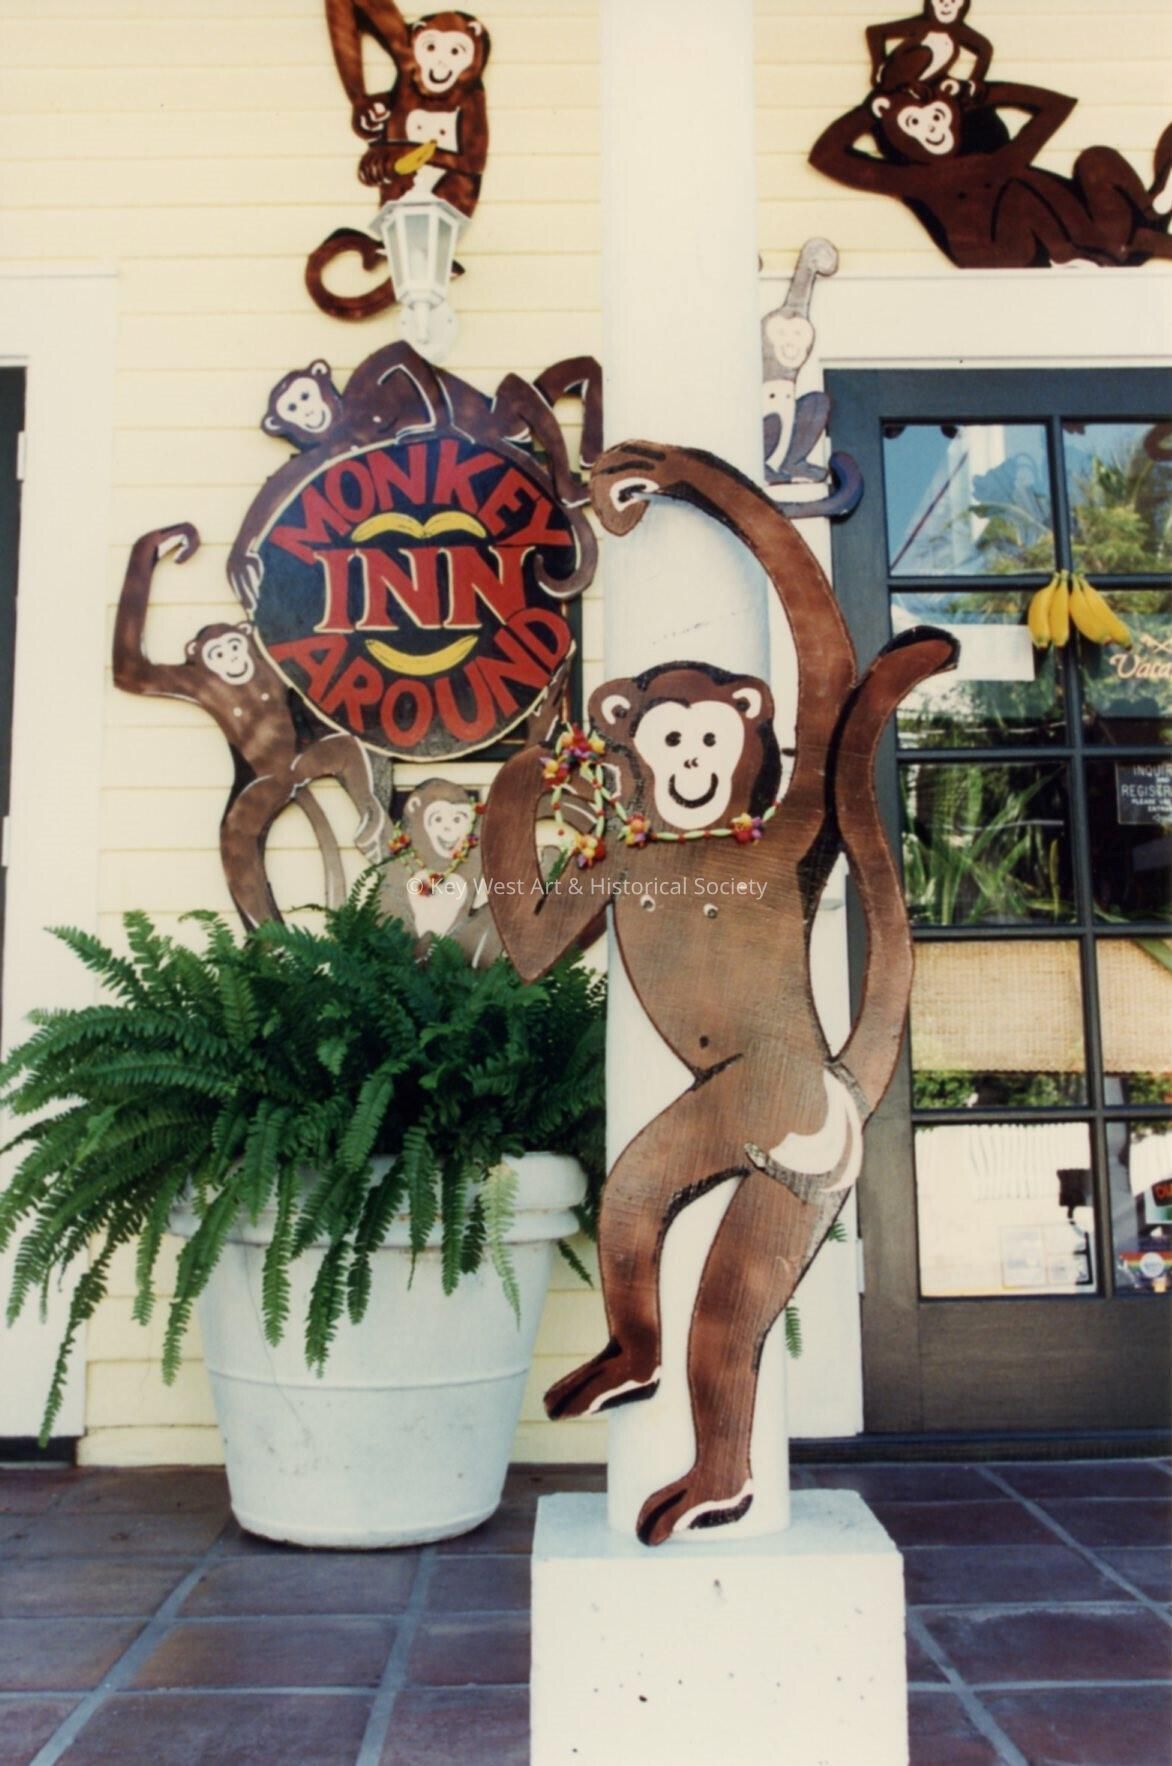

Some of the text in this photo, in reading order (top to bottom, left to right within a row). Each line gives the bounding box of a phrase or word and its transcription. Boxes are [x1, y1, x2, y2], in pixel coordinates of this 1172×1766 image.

[270, 439, 575, 565] MONKEY
[313, 546, 537, 633] INN
[269, 607, 572, 747] AROUND
[1121, 784, 1172, 798] REGISTR
